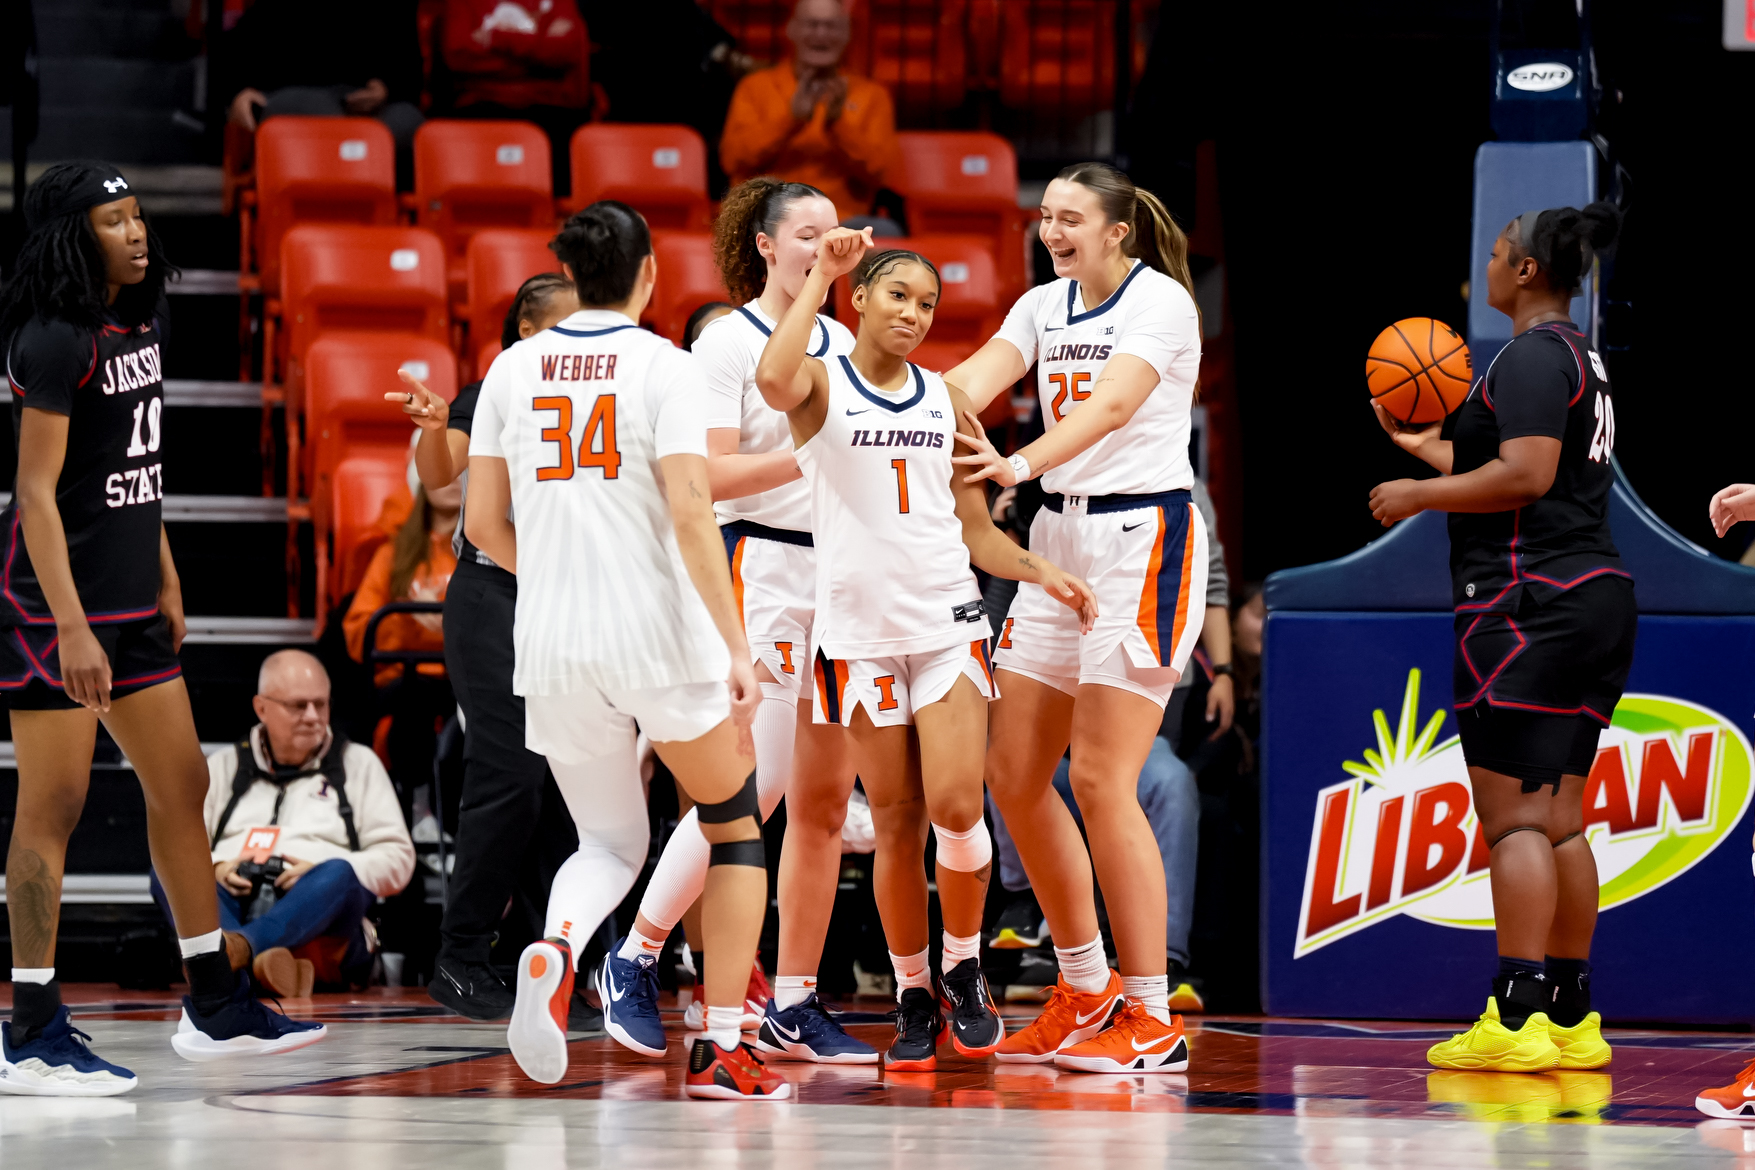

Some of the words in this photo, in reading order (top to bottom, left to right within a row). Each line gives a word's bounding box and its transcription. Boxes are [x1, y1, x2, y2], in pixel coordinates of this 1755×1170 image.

[102, 343, 162, 395] JACKSO
[541, 354, 618, 381] WEBBER
[1048, 372, 1092, 423] 25
[127, 397, 162, 457] 10
[532, 393, 622, 482] 34
[850, 430, 945, 449] ILLINOIS
[1588, 390, 1616, 465] 20
[891, 458, 910, 514] 1
[873, 674, 899, 712] I
[1303, 731, 1715, 940] LIBAN
